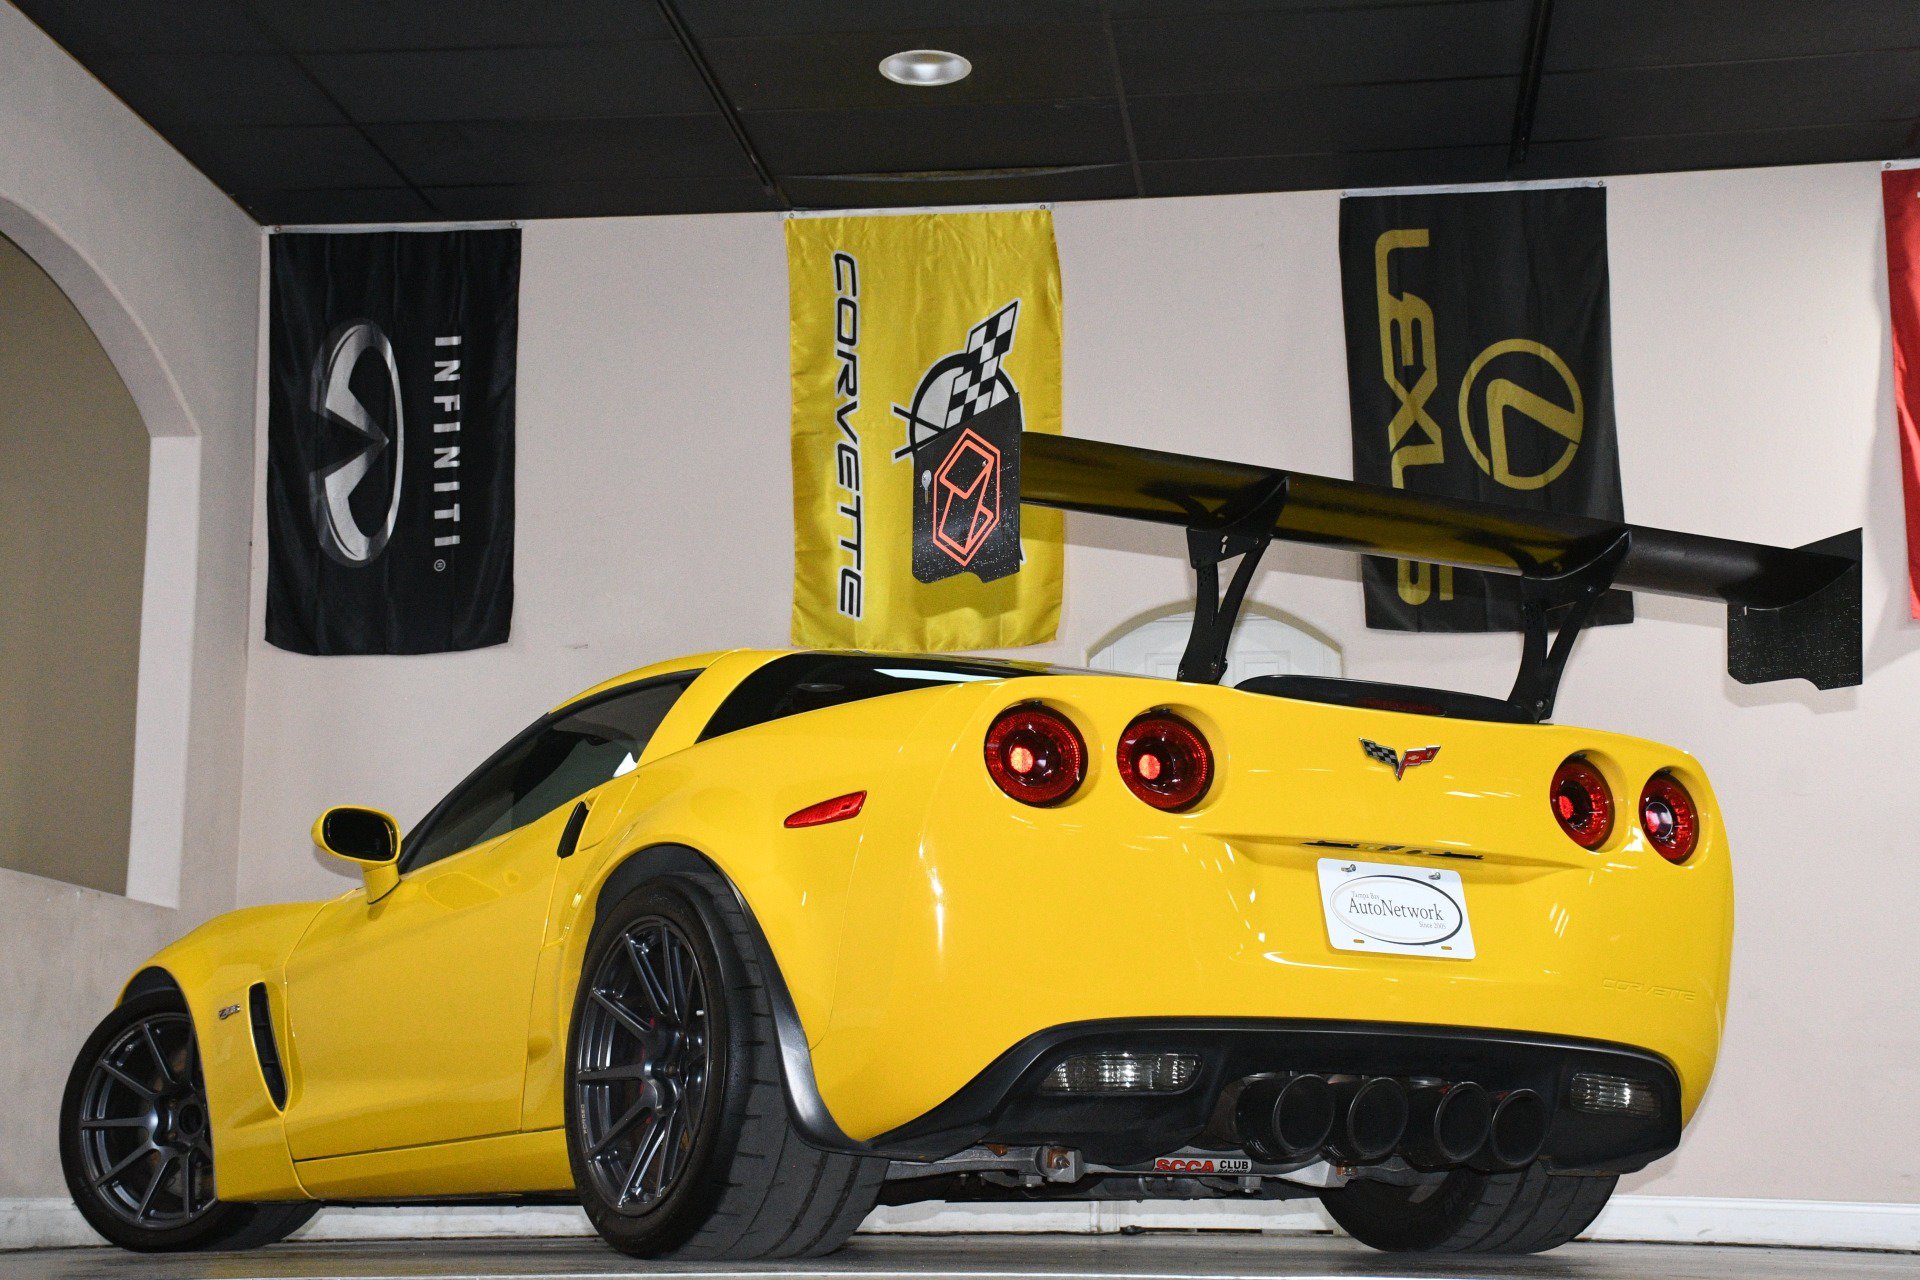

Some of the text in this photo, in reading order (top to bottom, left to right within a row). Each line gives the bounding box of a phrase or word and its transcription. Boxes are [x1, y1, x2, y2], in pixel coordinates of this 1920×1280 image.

[433, 336, 462, 547] INFINITI
[831, 250, 863, 619] CORVETTE
[1349, 898, 1443, 921] AutoNetwork
[1602, 978, 1695, 1001] CORVETTE
[1154, 1159, 1249, 1173] SCCA CLUB
